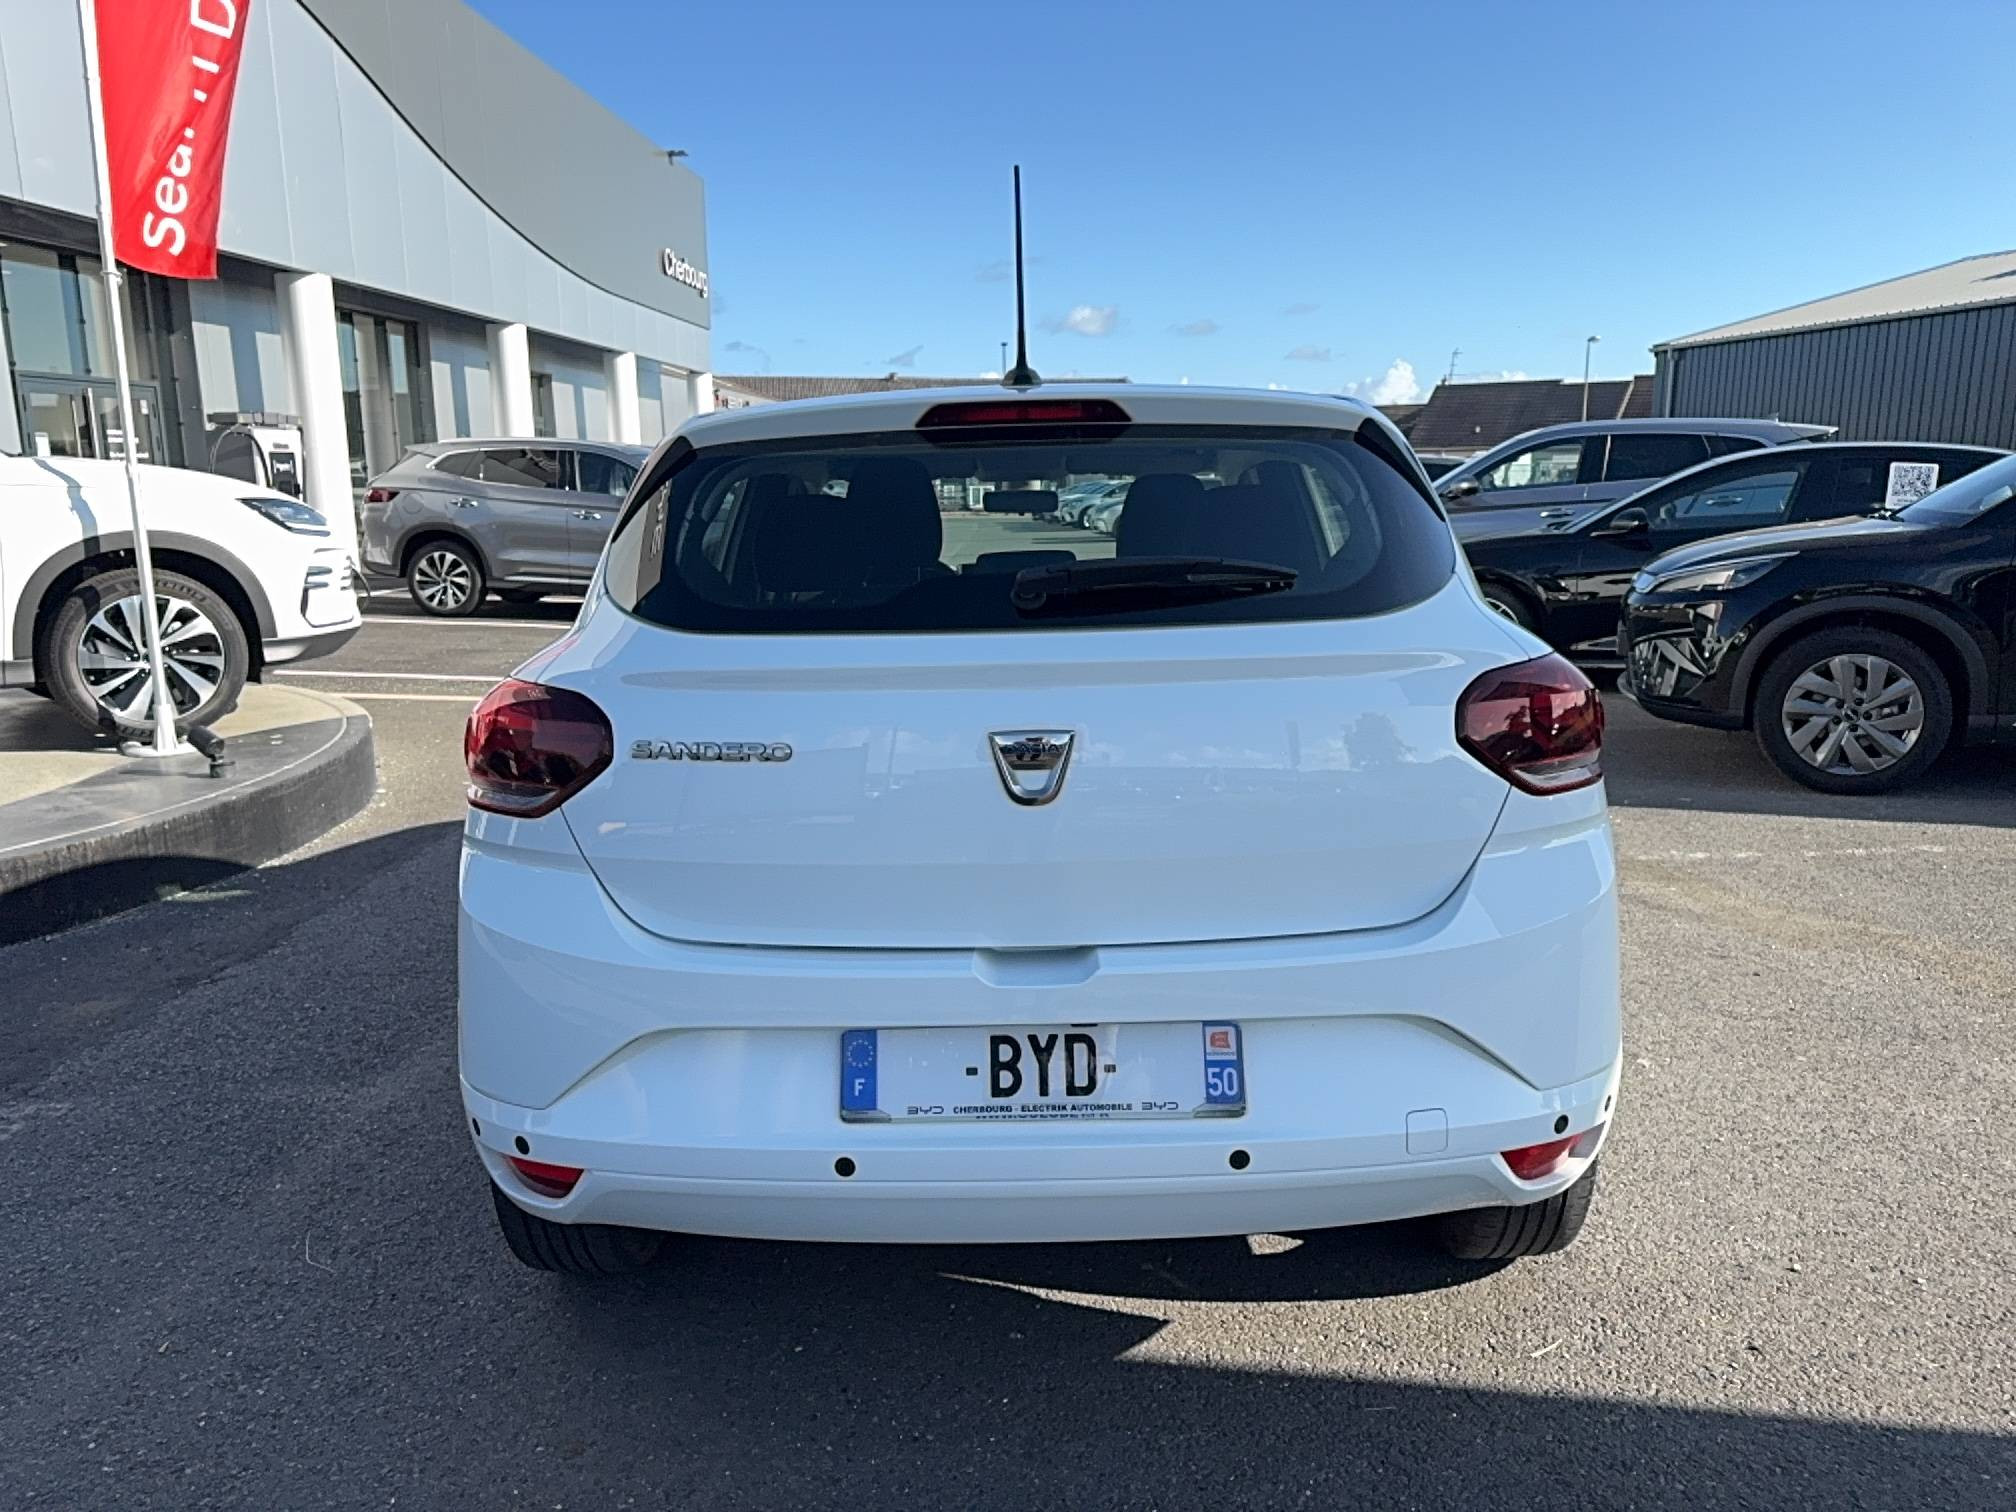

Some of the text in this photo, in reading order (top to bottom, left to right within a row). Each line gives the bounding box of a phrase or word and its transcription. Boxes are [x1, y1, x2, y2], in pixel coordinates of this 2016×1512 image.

[631, 739, 793, 762] SANDERO
[854, 1078, 866, 1097] F
[1207, 1067, 1238, 1096] 50
[907, 1105, 945, 1115] BYD
[953, 1105, 1013, 1114] CHERBOURG
[1070, 1102, 1133, 1112] AUTOMOBILE
[1141, 1101, 1179, 1111] BYD
